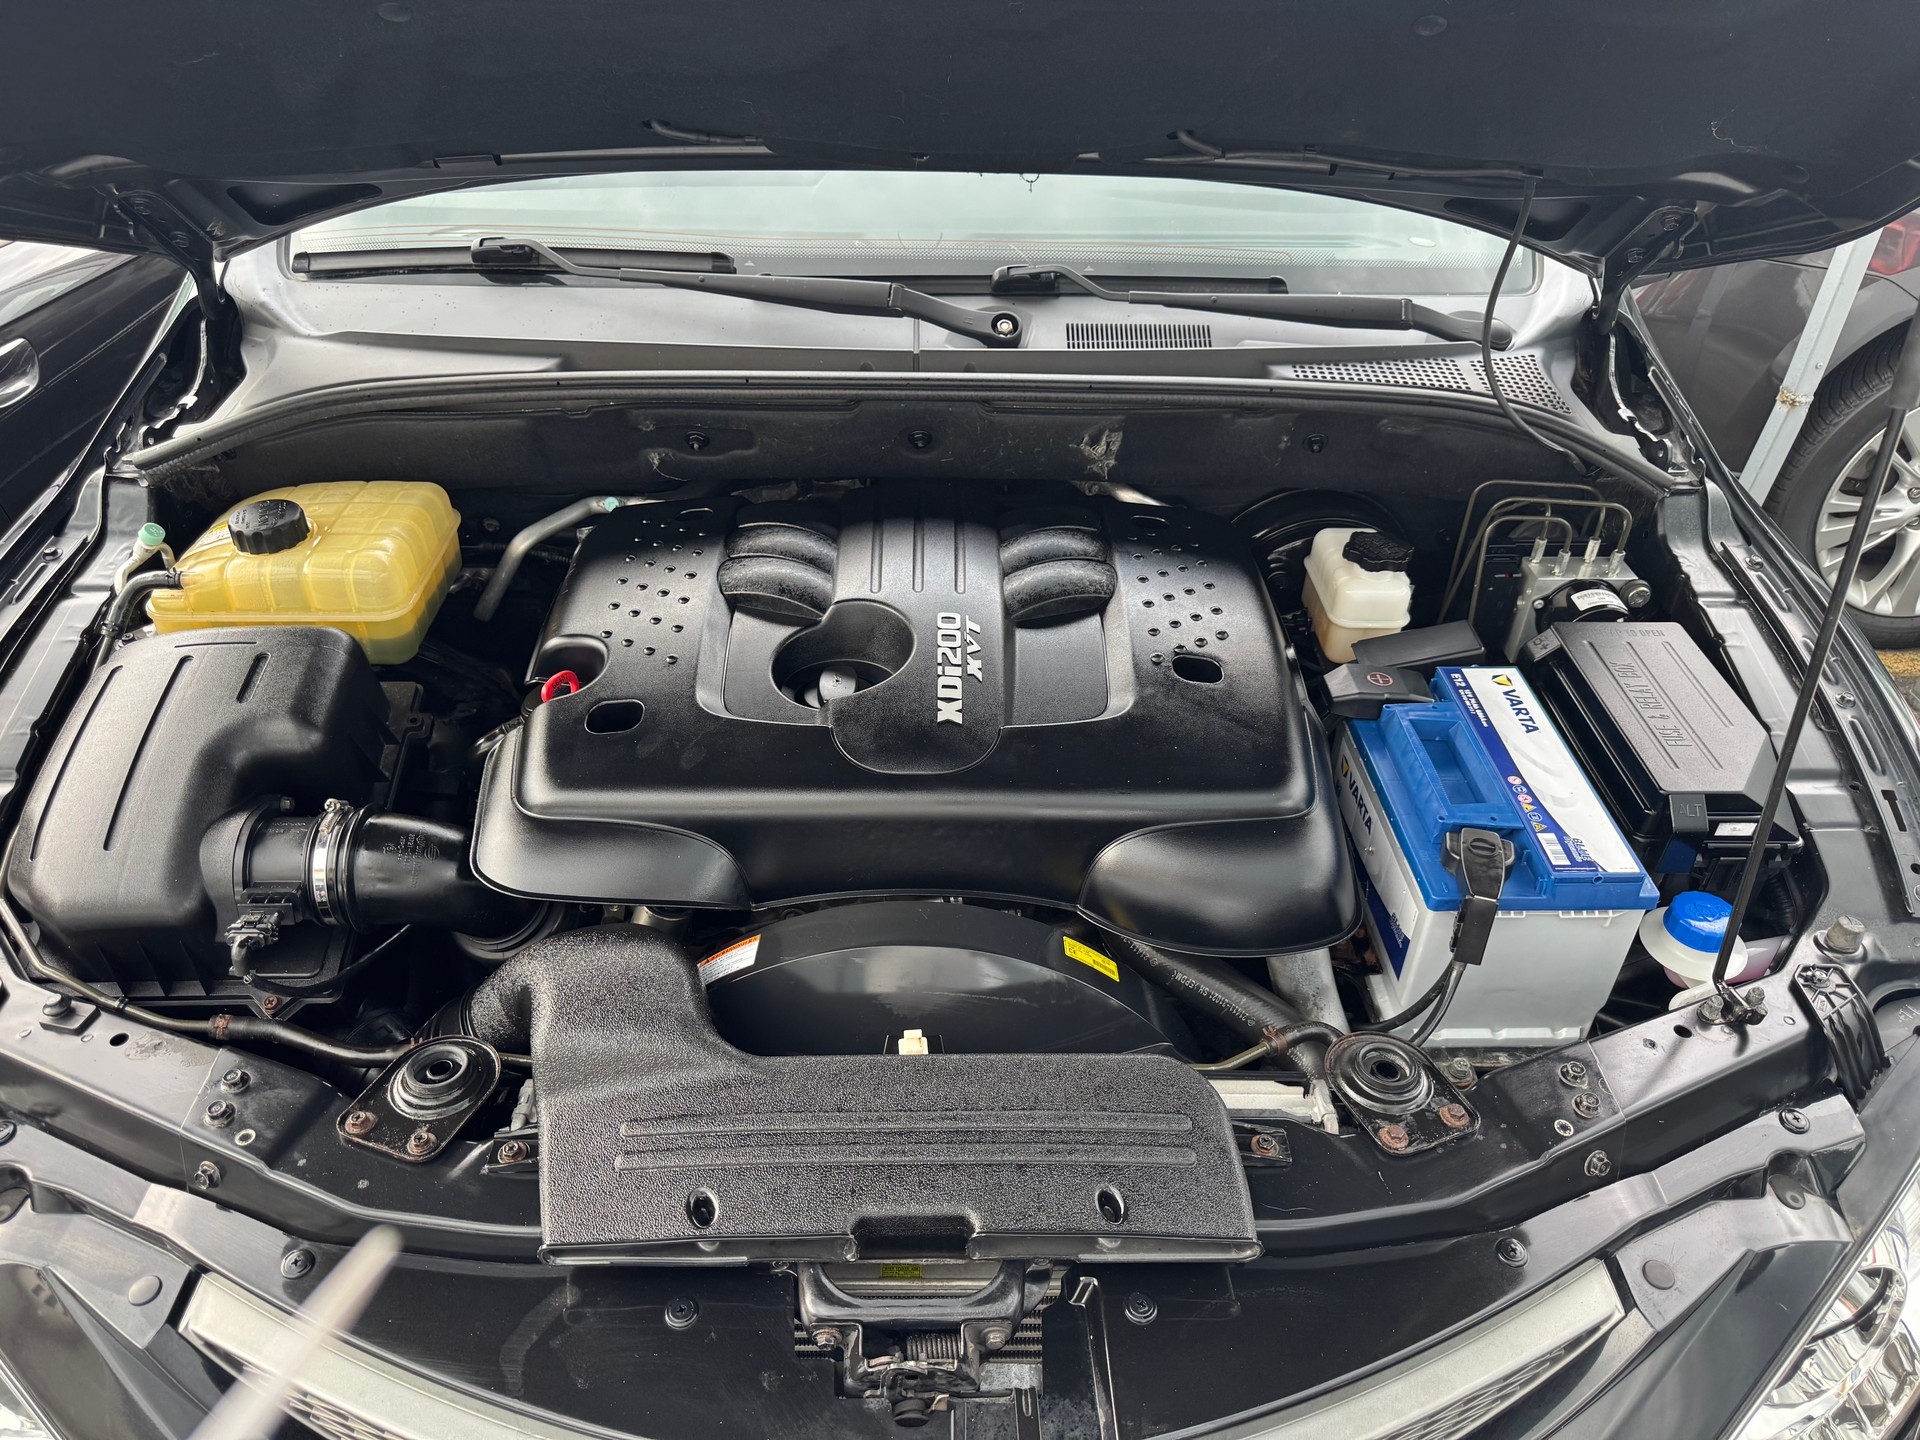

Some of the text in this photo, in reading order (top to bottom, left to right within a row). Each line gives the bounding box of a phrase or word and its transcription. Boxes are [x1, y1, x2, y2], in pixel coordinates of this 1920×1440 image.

[937, 612, 963, 725] XDi200
[1609, 661, 1642, 678] BOX
[1623, 682, 1665, 710] RELAY
[1502, 688, 1540, 734] VARTA
[1655, 724, 1693, 747] FUSE
[1347, 771, 1374, 836] VARTA
[1677, 803, 1703, 817] ALT
